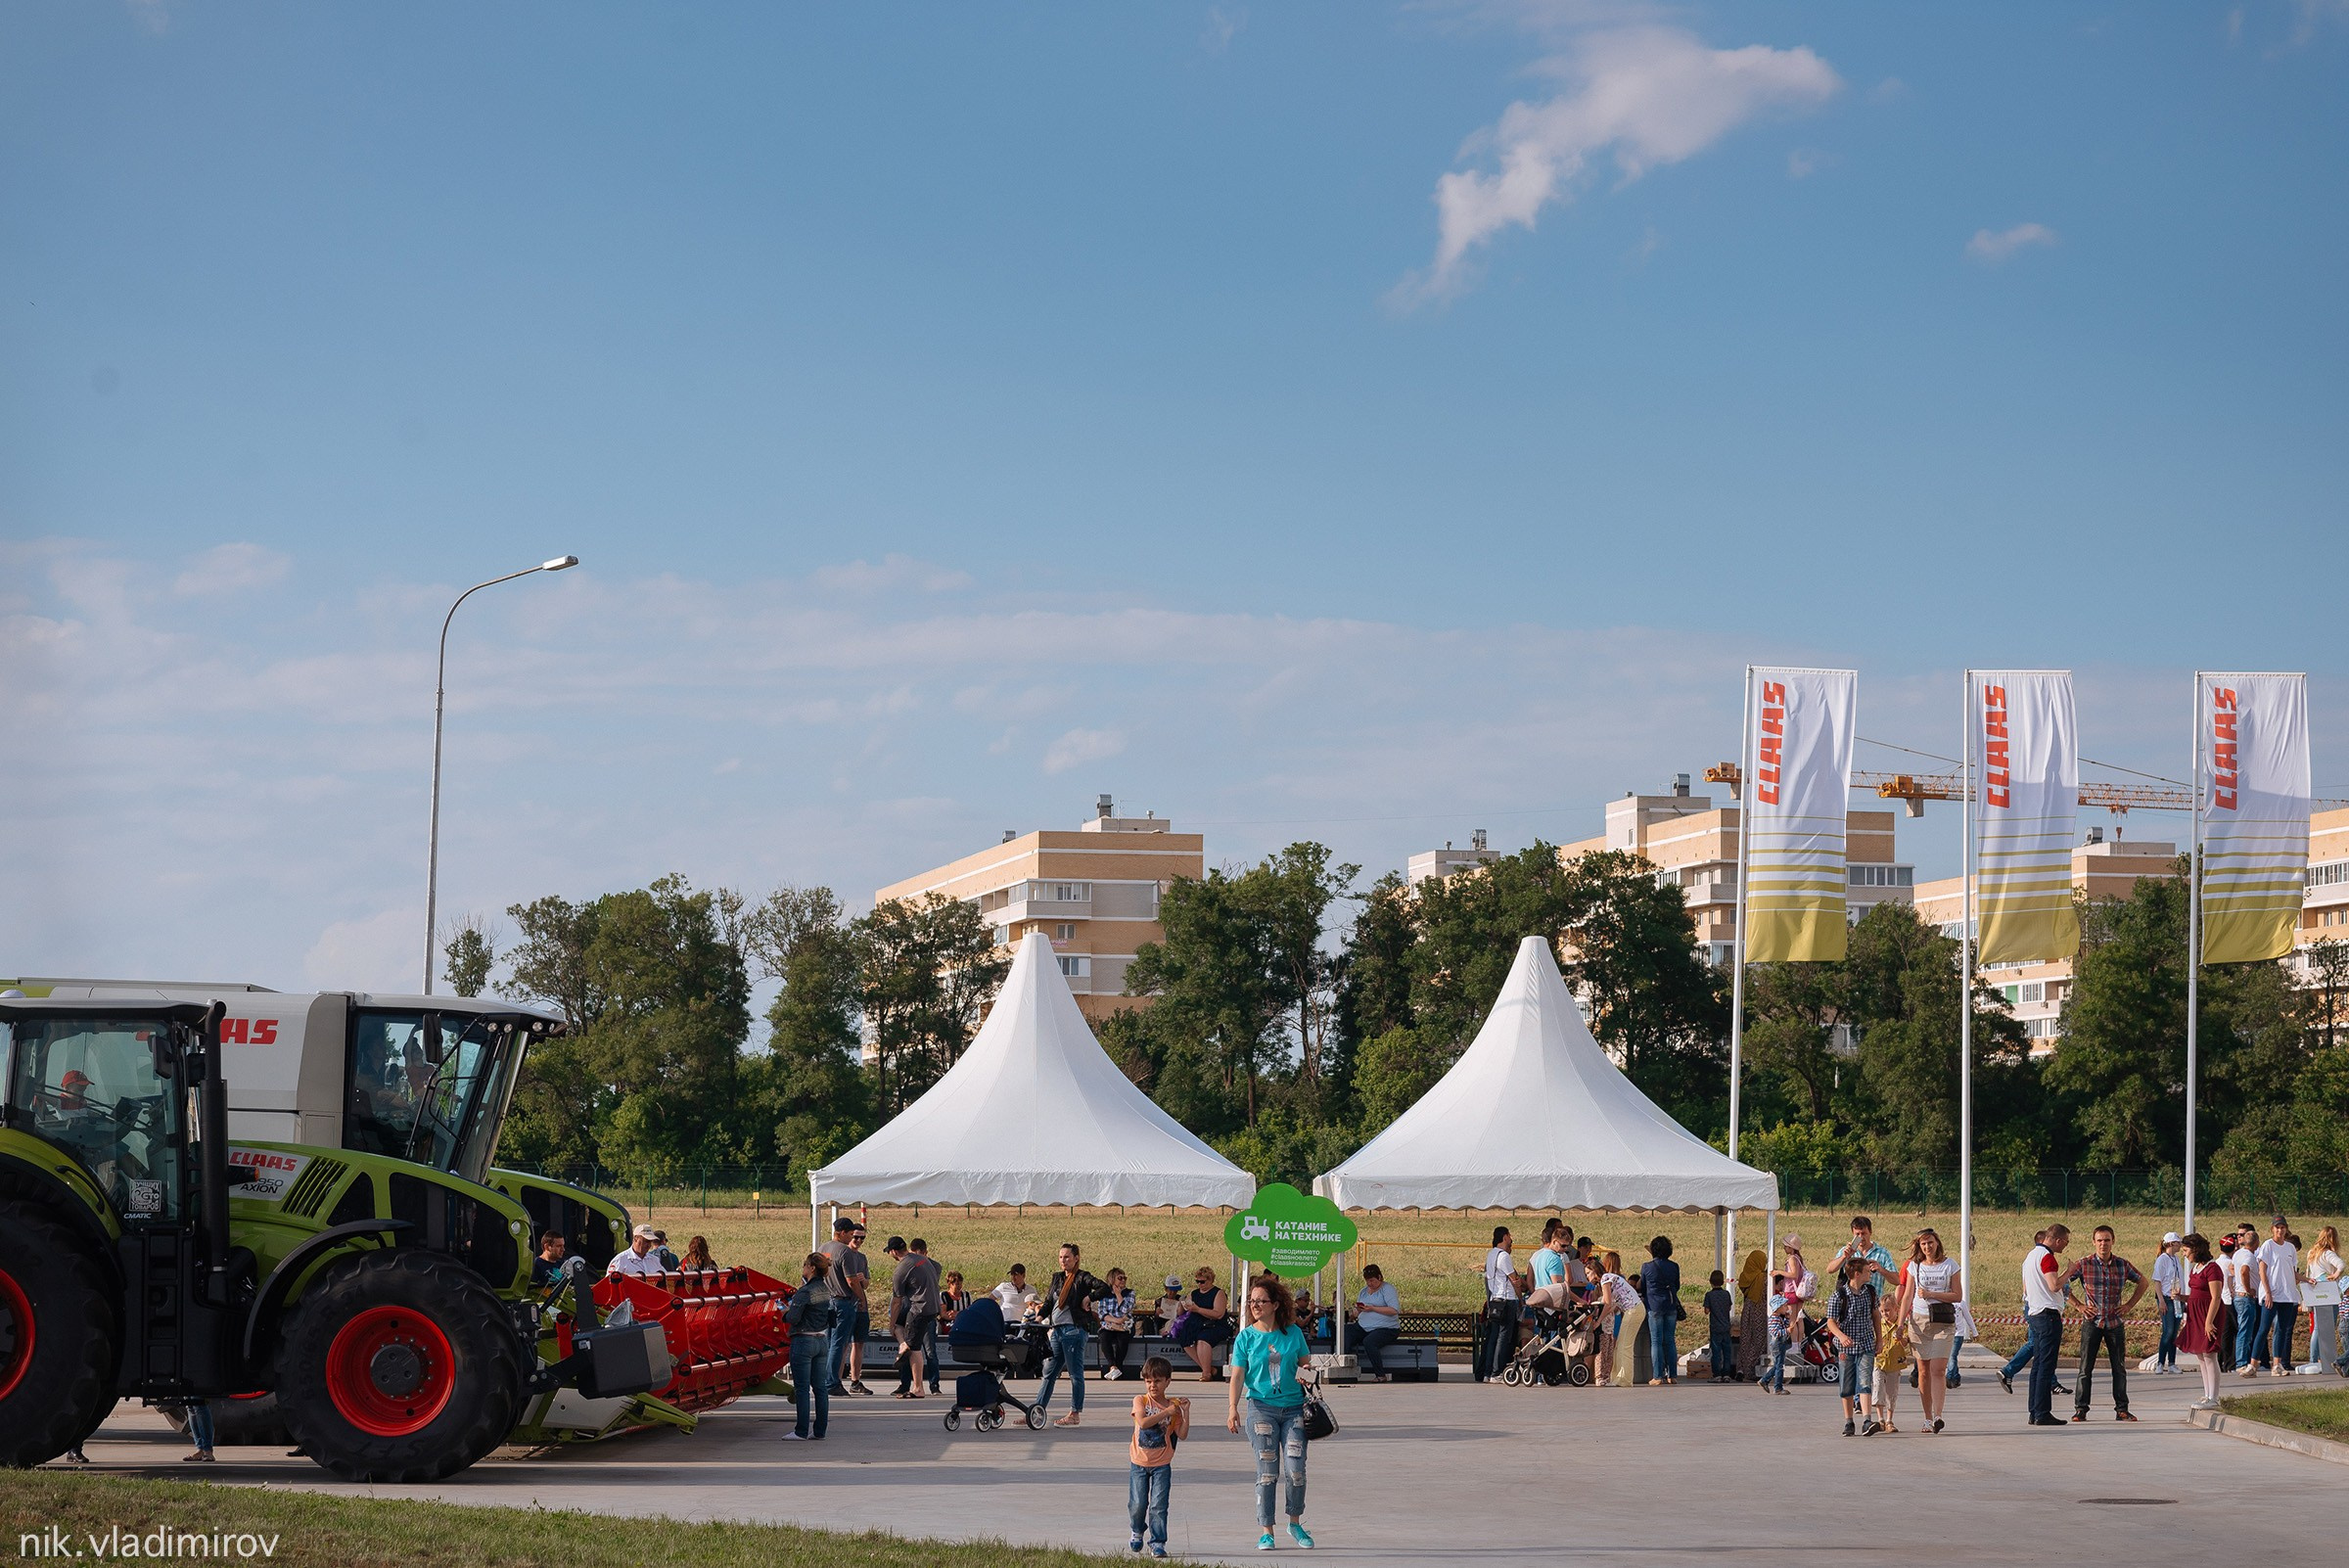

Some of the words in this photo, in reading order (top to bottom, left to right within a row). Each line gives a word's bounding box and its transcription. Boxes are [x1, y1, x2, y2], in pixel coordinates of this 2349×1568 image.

[1758, 680, 1786, 806] CLAAS
[1984, 684, 2010, 808] CLAAS
[2214, 686, 2237, 811] CLAAS
[220, 1018, 279, 1045] AS
[229, 1151, 298, 1172] CLAAS
[240, 1182, 279, 1194] AXION
[257, 1177, 284, 1187] 950
[1274, 1221, 1328, 1231] КАТАНИЕ
